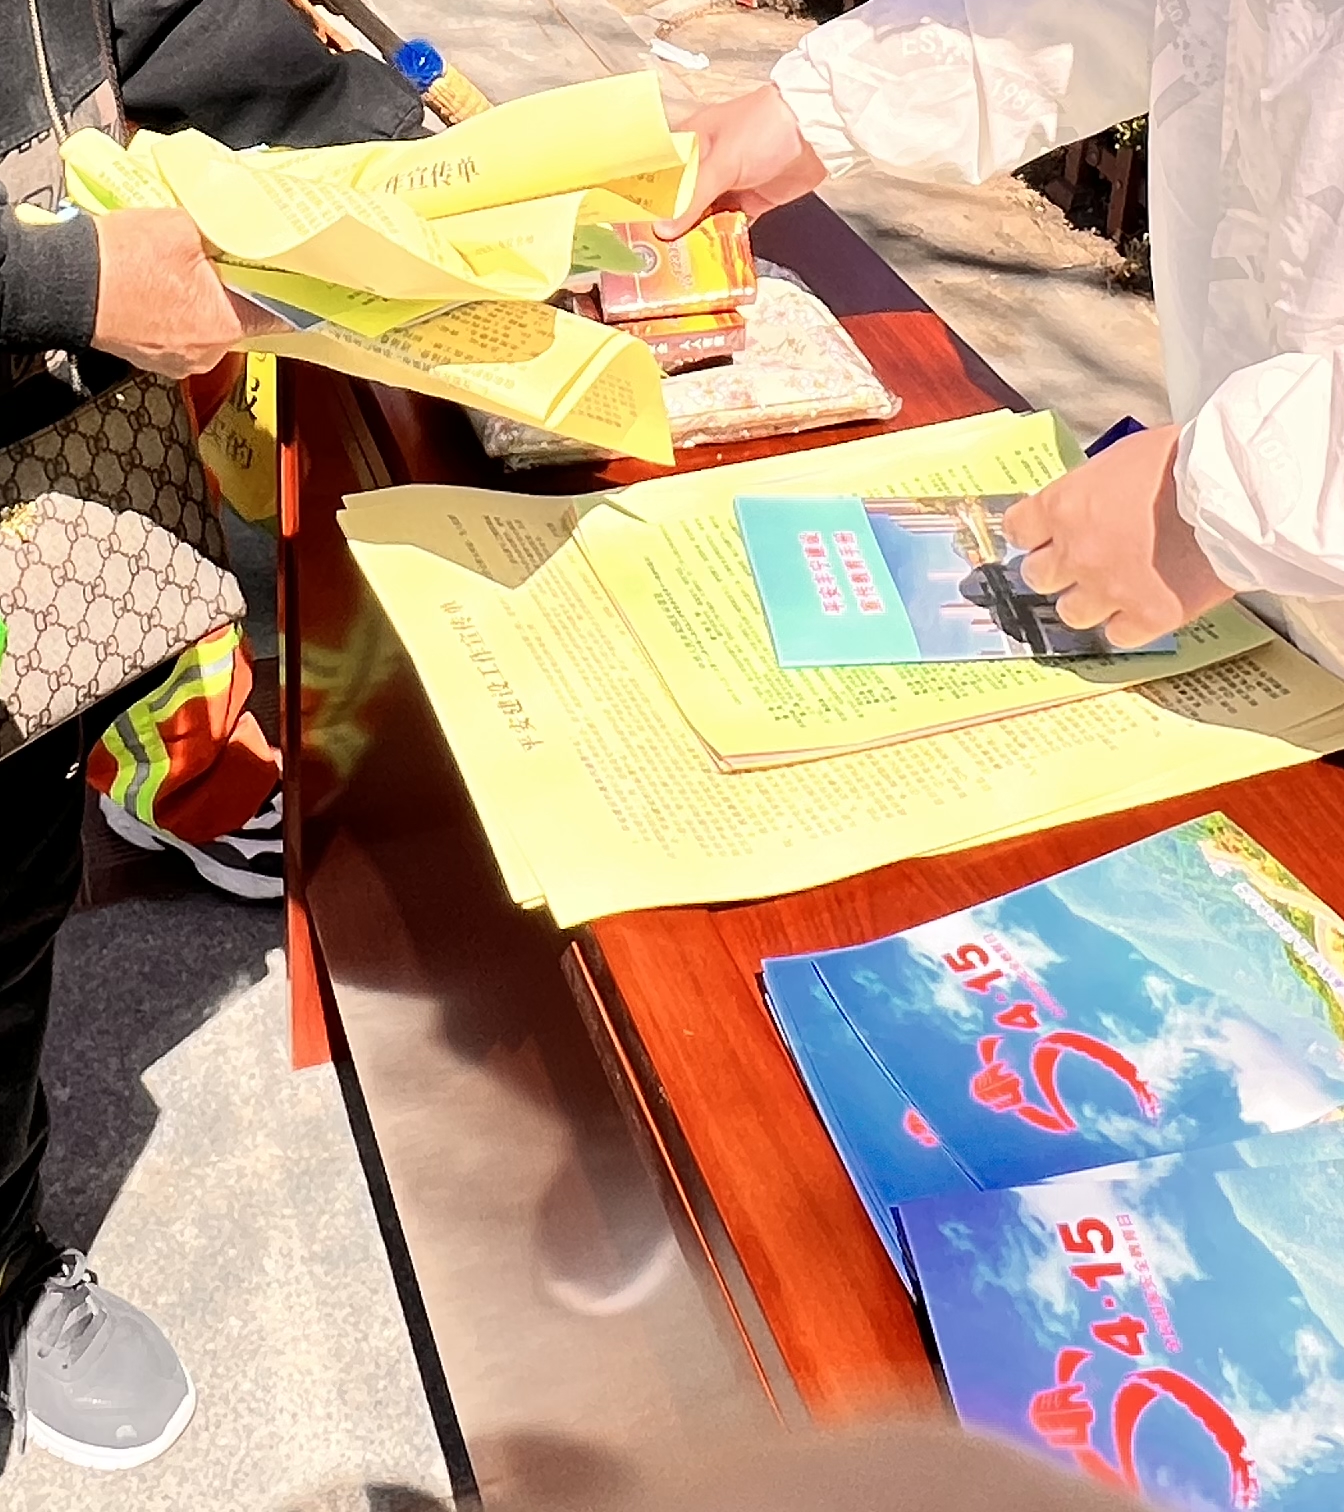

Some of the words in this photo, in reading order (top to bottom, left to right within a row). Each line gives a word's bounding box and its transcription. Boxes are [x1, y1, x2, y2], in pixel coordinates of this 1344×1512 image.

[440, 600, 545, 752] 平安建设工作宣传单
